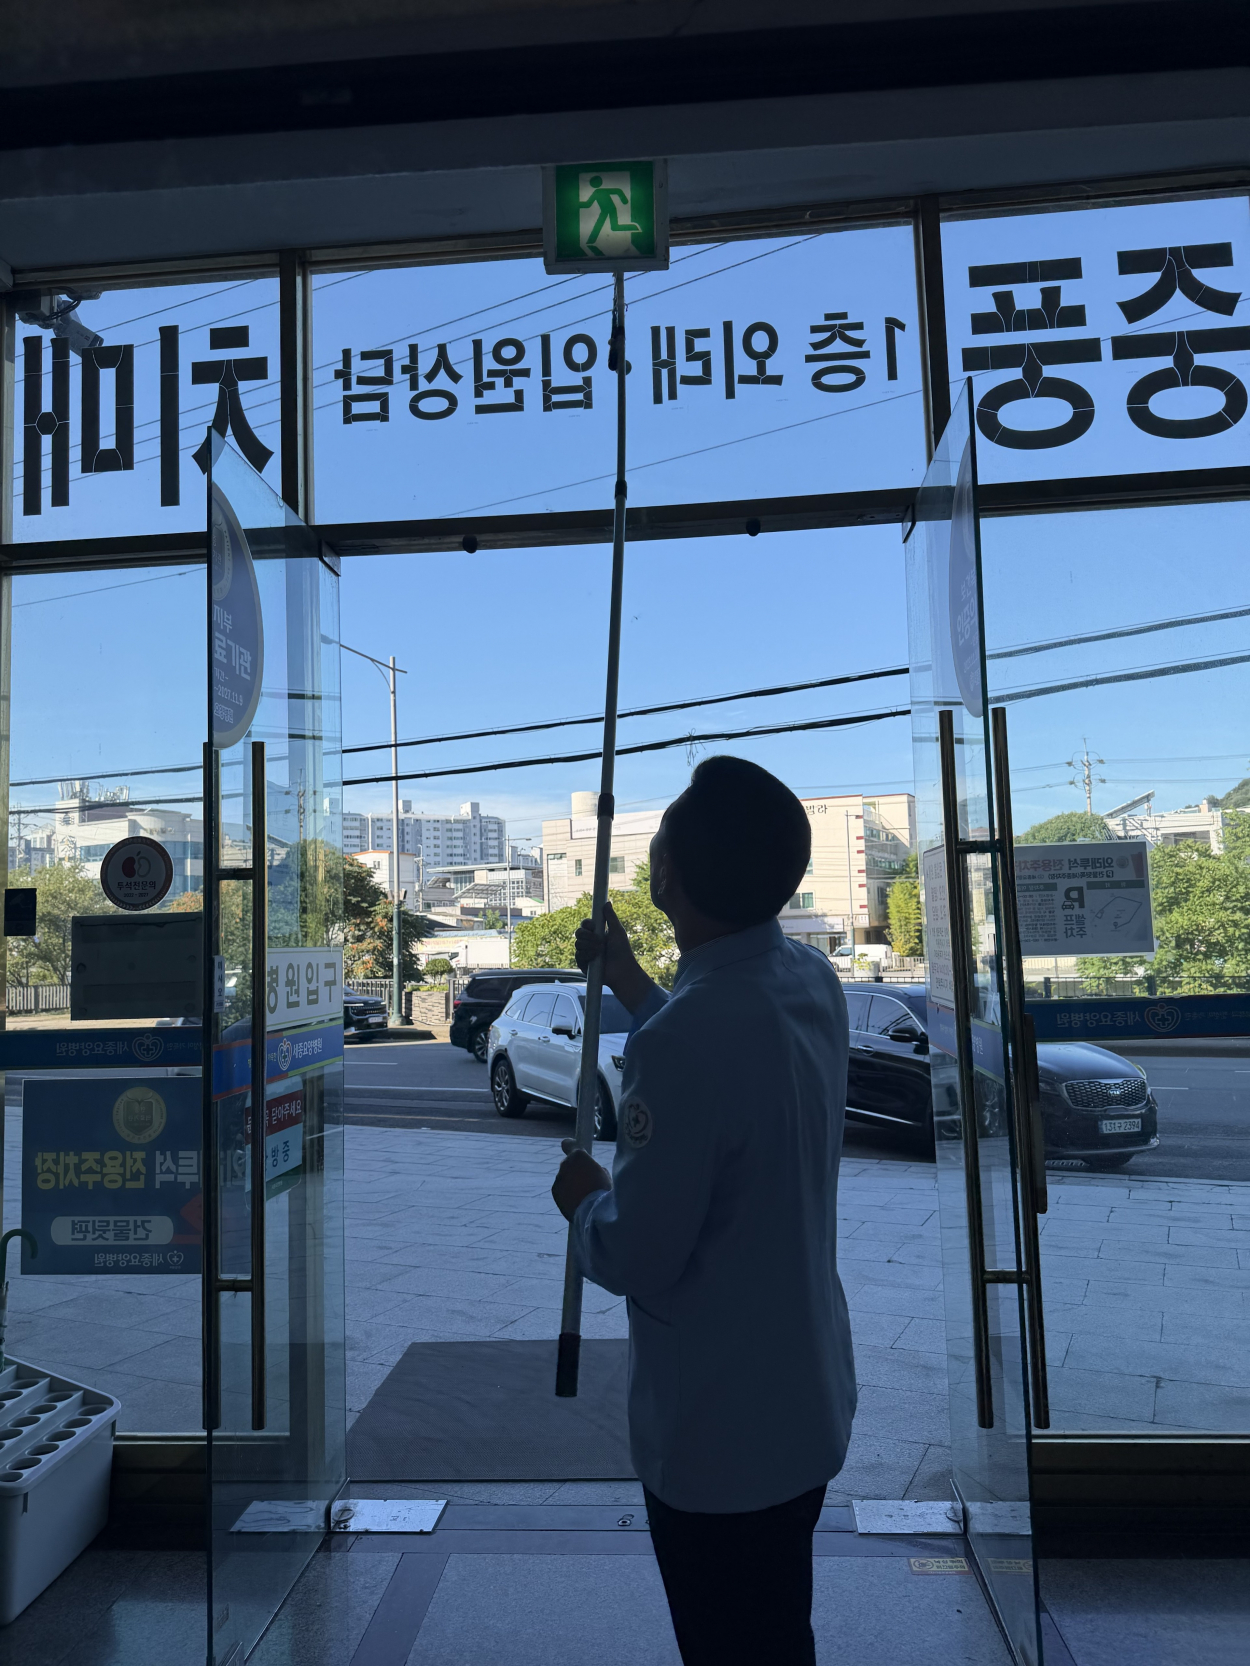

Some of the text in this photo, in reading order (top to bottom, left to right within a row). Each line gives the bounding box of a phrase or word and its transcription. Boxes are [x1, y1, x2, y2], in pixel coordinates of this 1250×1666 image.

[214, 632, 252, 680] 료기관
[266, 962, 337, 1014] 병원입구
[293, 1037, 323, 1058] 세종요양병원
[271, 1100, 302, 1125] 닫아주세요
